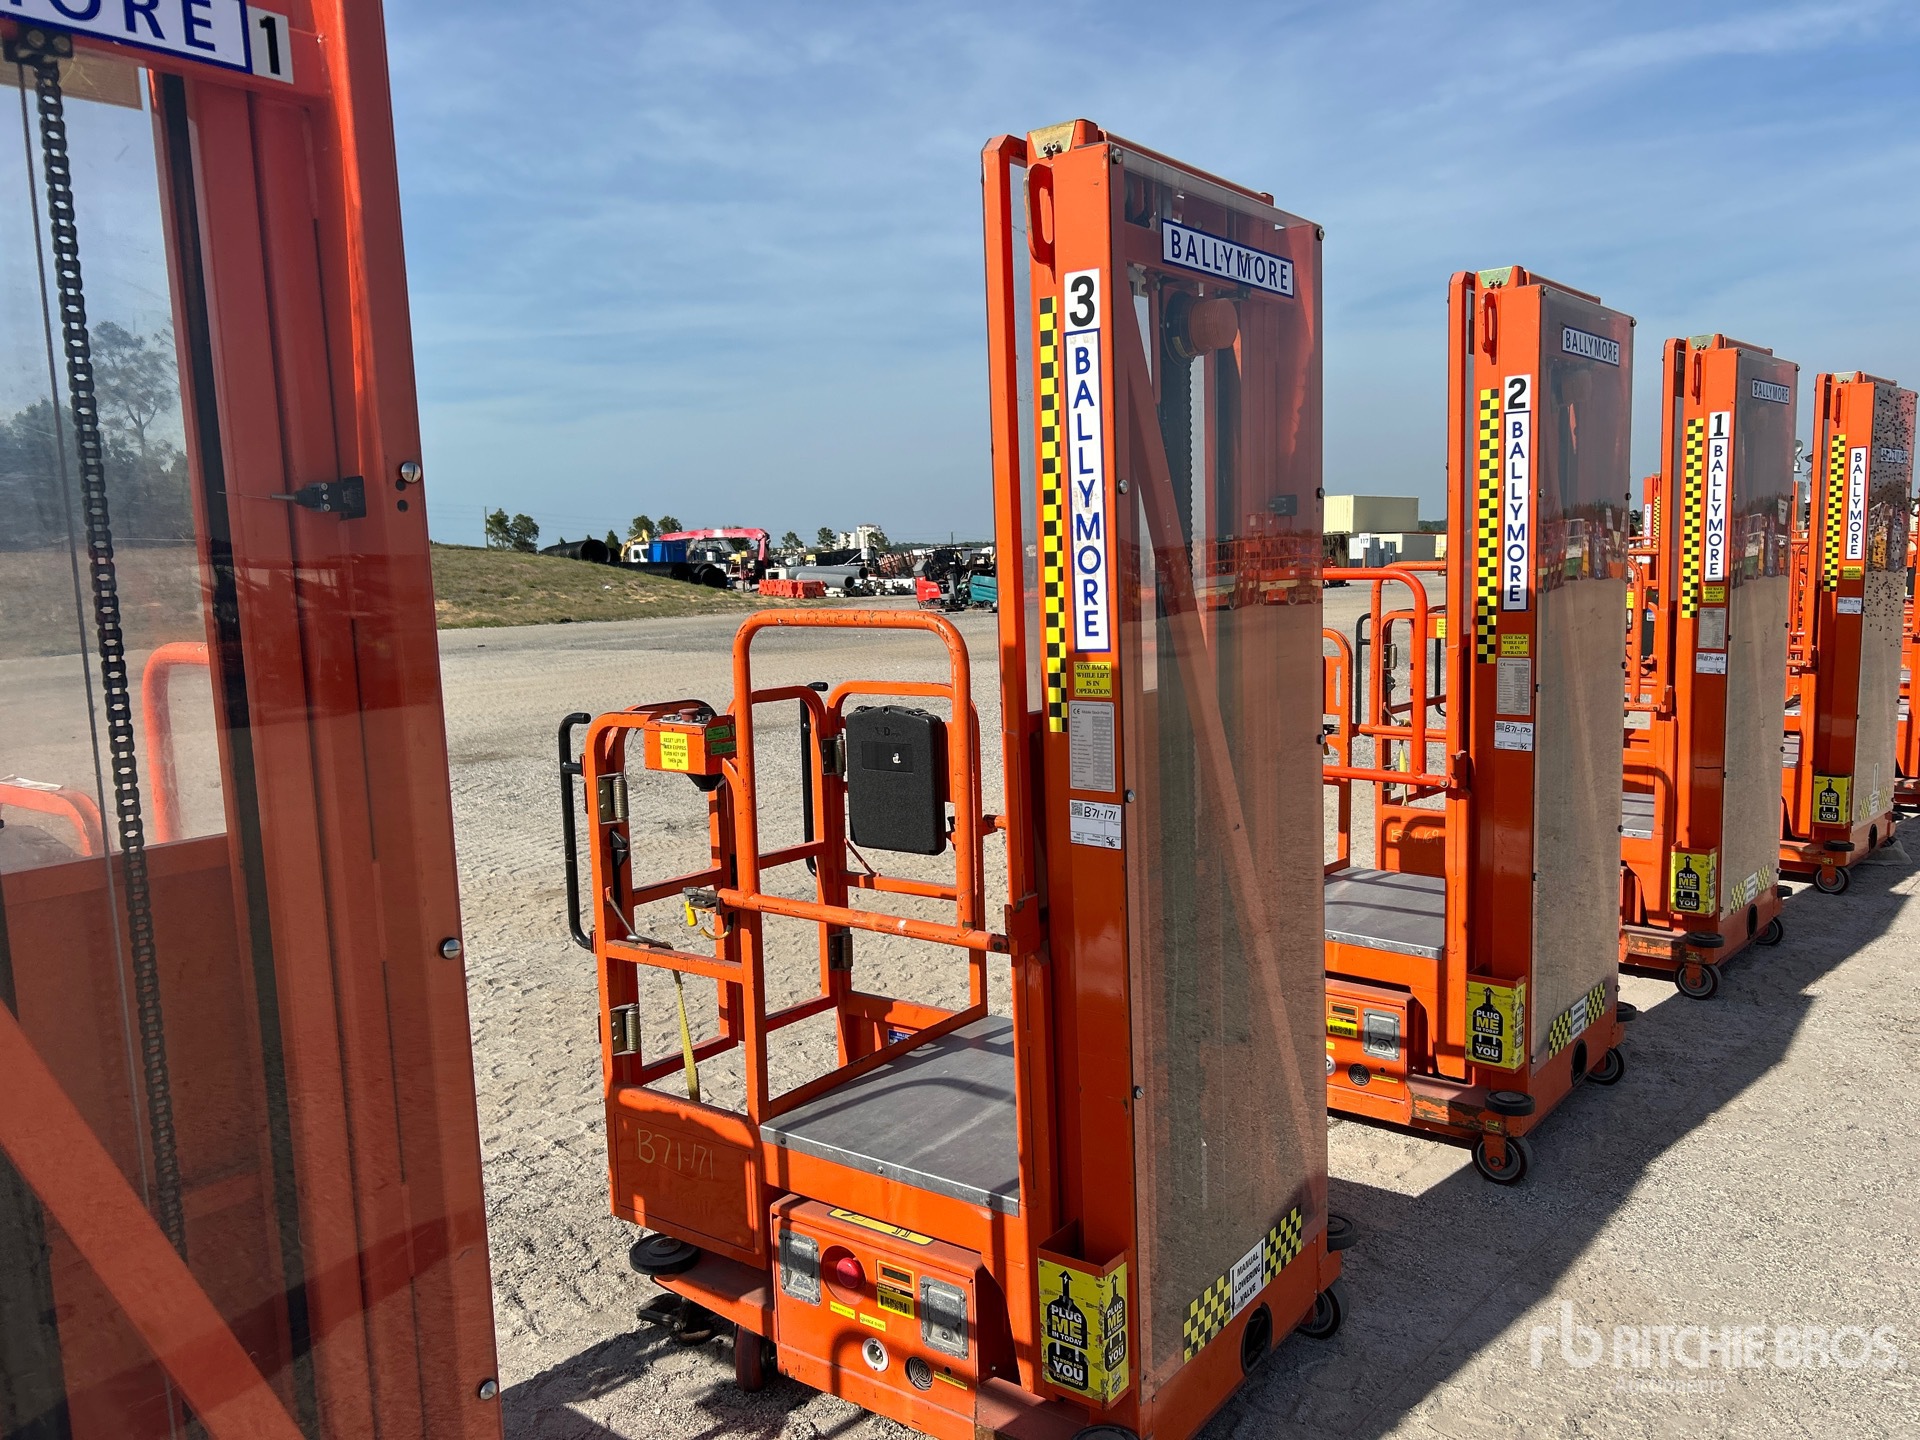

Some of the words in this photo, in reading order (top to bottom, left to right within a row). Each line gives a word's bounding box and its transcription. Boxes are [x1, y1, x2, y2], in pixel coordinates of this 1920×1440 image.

[259, 15, 281, 75] 1
[1171, 229, 1288, 291] BALLYMORE
[1068, 275, 1096, 328] 3
[1565, 330, 1617, 362] BALLYMORE
[1507, 377, 1527, 410] 2
[1753, 382, 1789, 402] BALLYMORE
[1713, 413, 1724, 437] 1
[1072, 345, 1101, 637] BALLYMORE
[1507, 421, 1526, 603] BALLYMORE
[1708, 445, 1724, 576] BALLYMORE
[1849, 452, 1863, 555] BALLYMORE
[1084, 806, 1117, 821] B71-171
[1678, 877, 1697, 887] ME
[1476, 1010, 1500, 1020] PLUG
[1476, 1017, 1500, 1031] ME
[1476, 1045, 1499, 1057] YOU
[637, 1128, 714, 1180] B71-171
[1237, 1251, 1259, 1277] MANUAL
[1235, 1263, 1261, 1294] LOWERING
[1240, 1282, 1256, 1302] VALVE
[1051, 1305, 1082, 1324] PLUG
[1107, 1301, 1123, 1318] PLUG
[1107, 1309, 1123, 1331] ME
[1051, 1315, 1082, 1340] ME
[1051, 1330, 1059, 1339] IN
[1060, 1333, 1083, 1346] TODAY
[1108, 1345, 1124, 1364] YOU
[1053, 1360, 1084, 1382] YOU
